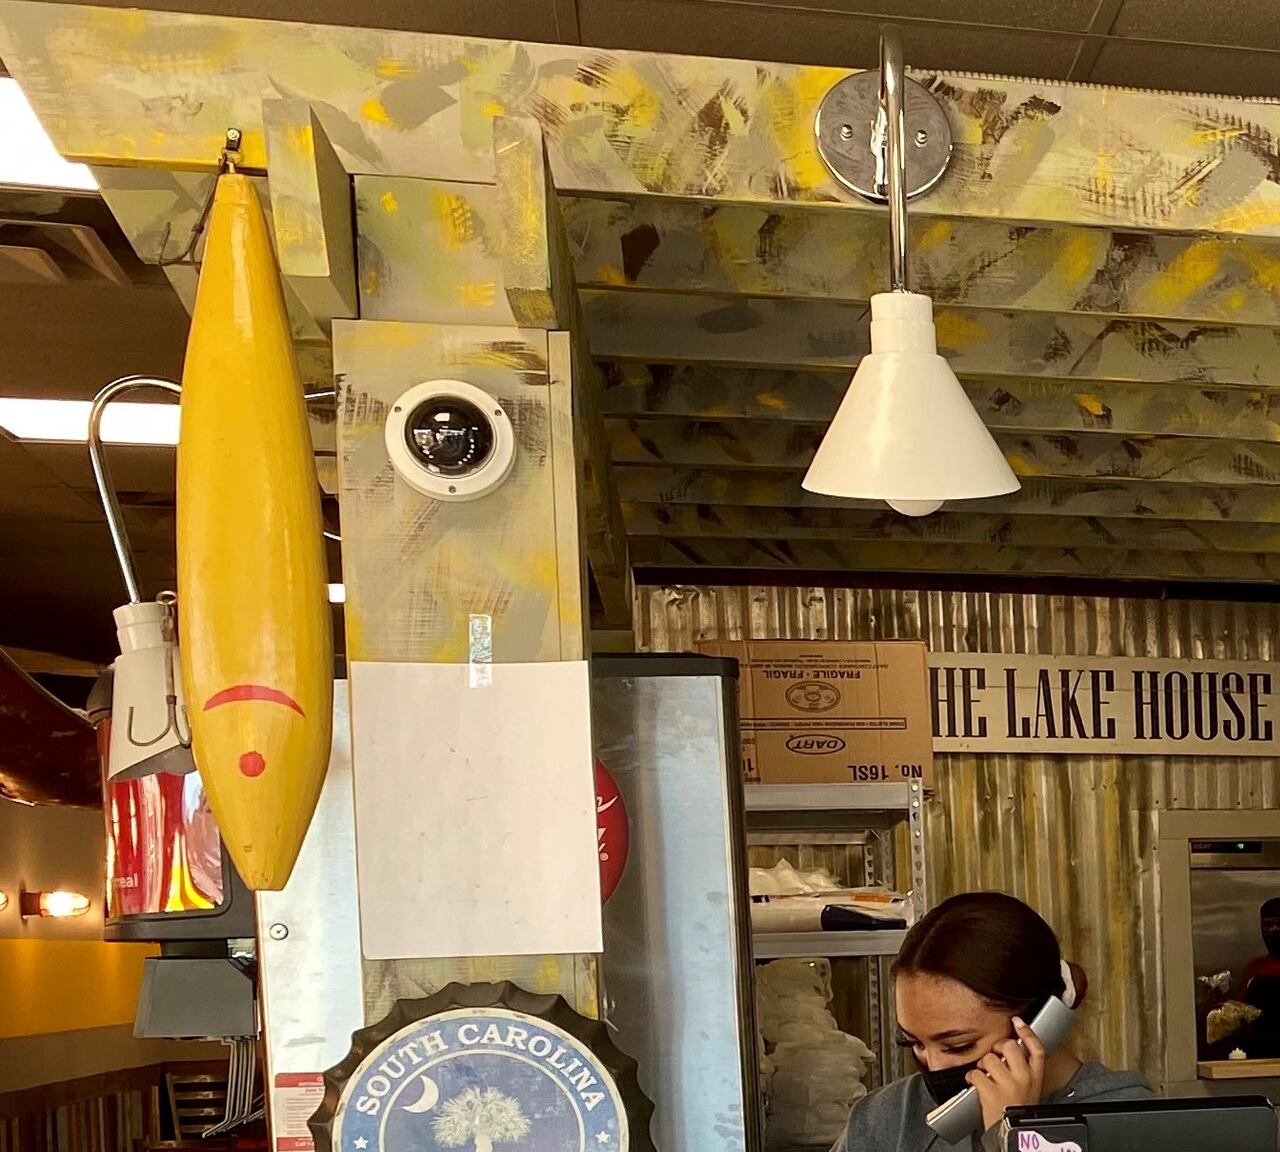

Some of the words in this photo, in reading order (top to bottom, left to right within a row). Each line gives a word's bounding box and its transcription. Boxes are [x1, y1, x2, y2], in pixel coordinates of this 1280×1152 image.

[762, 669, 804, 679] FRAGIL
[813, 670, 861, 679] FRAGILE
[929, 667, 987, 739] HE
[1004, 668, 1116, 740] LAKE
[1132, 669, 1273, 742] HOUSE
[792, 738, 839, 750] DART
[847, 764, 889, 781] 16SL
[895, 764, 922, 779] No.
[355, 1030, 448, 1116] SOUTH
[457, 1023, 605, 1112] CAROLINA
[1019, 1133, 1040, 1149] NO
